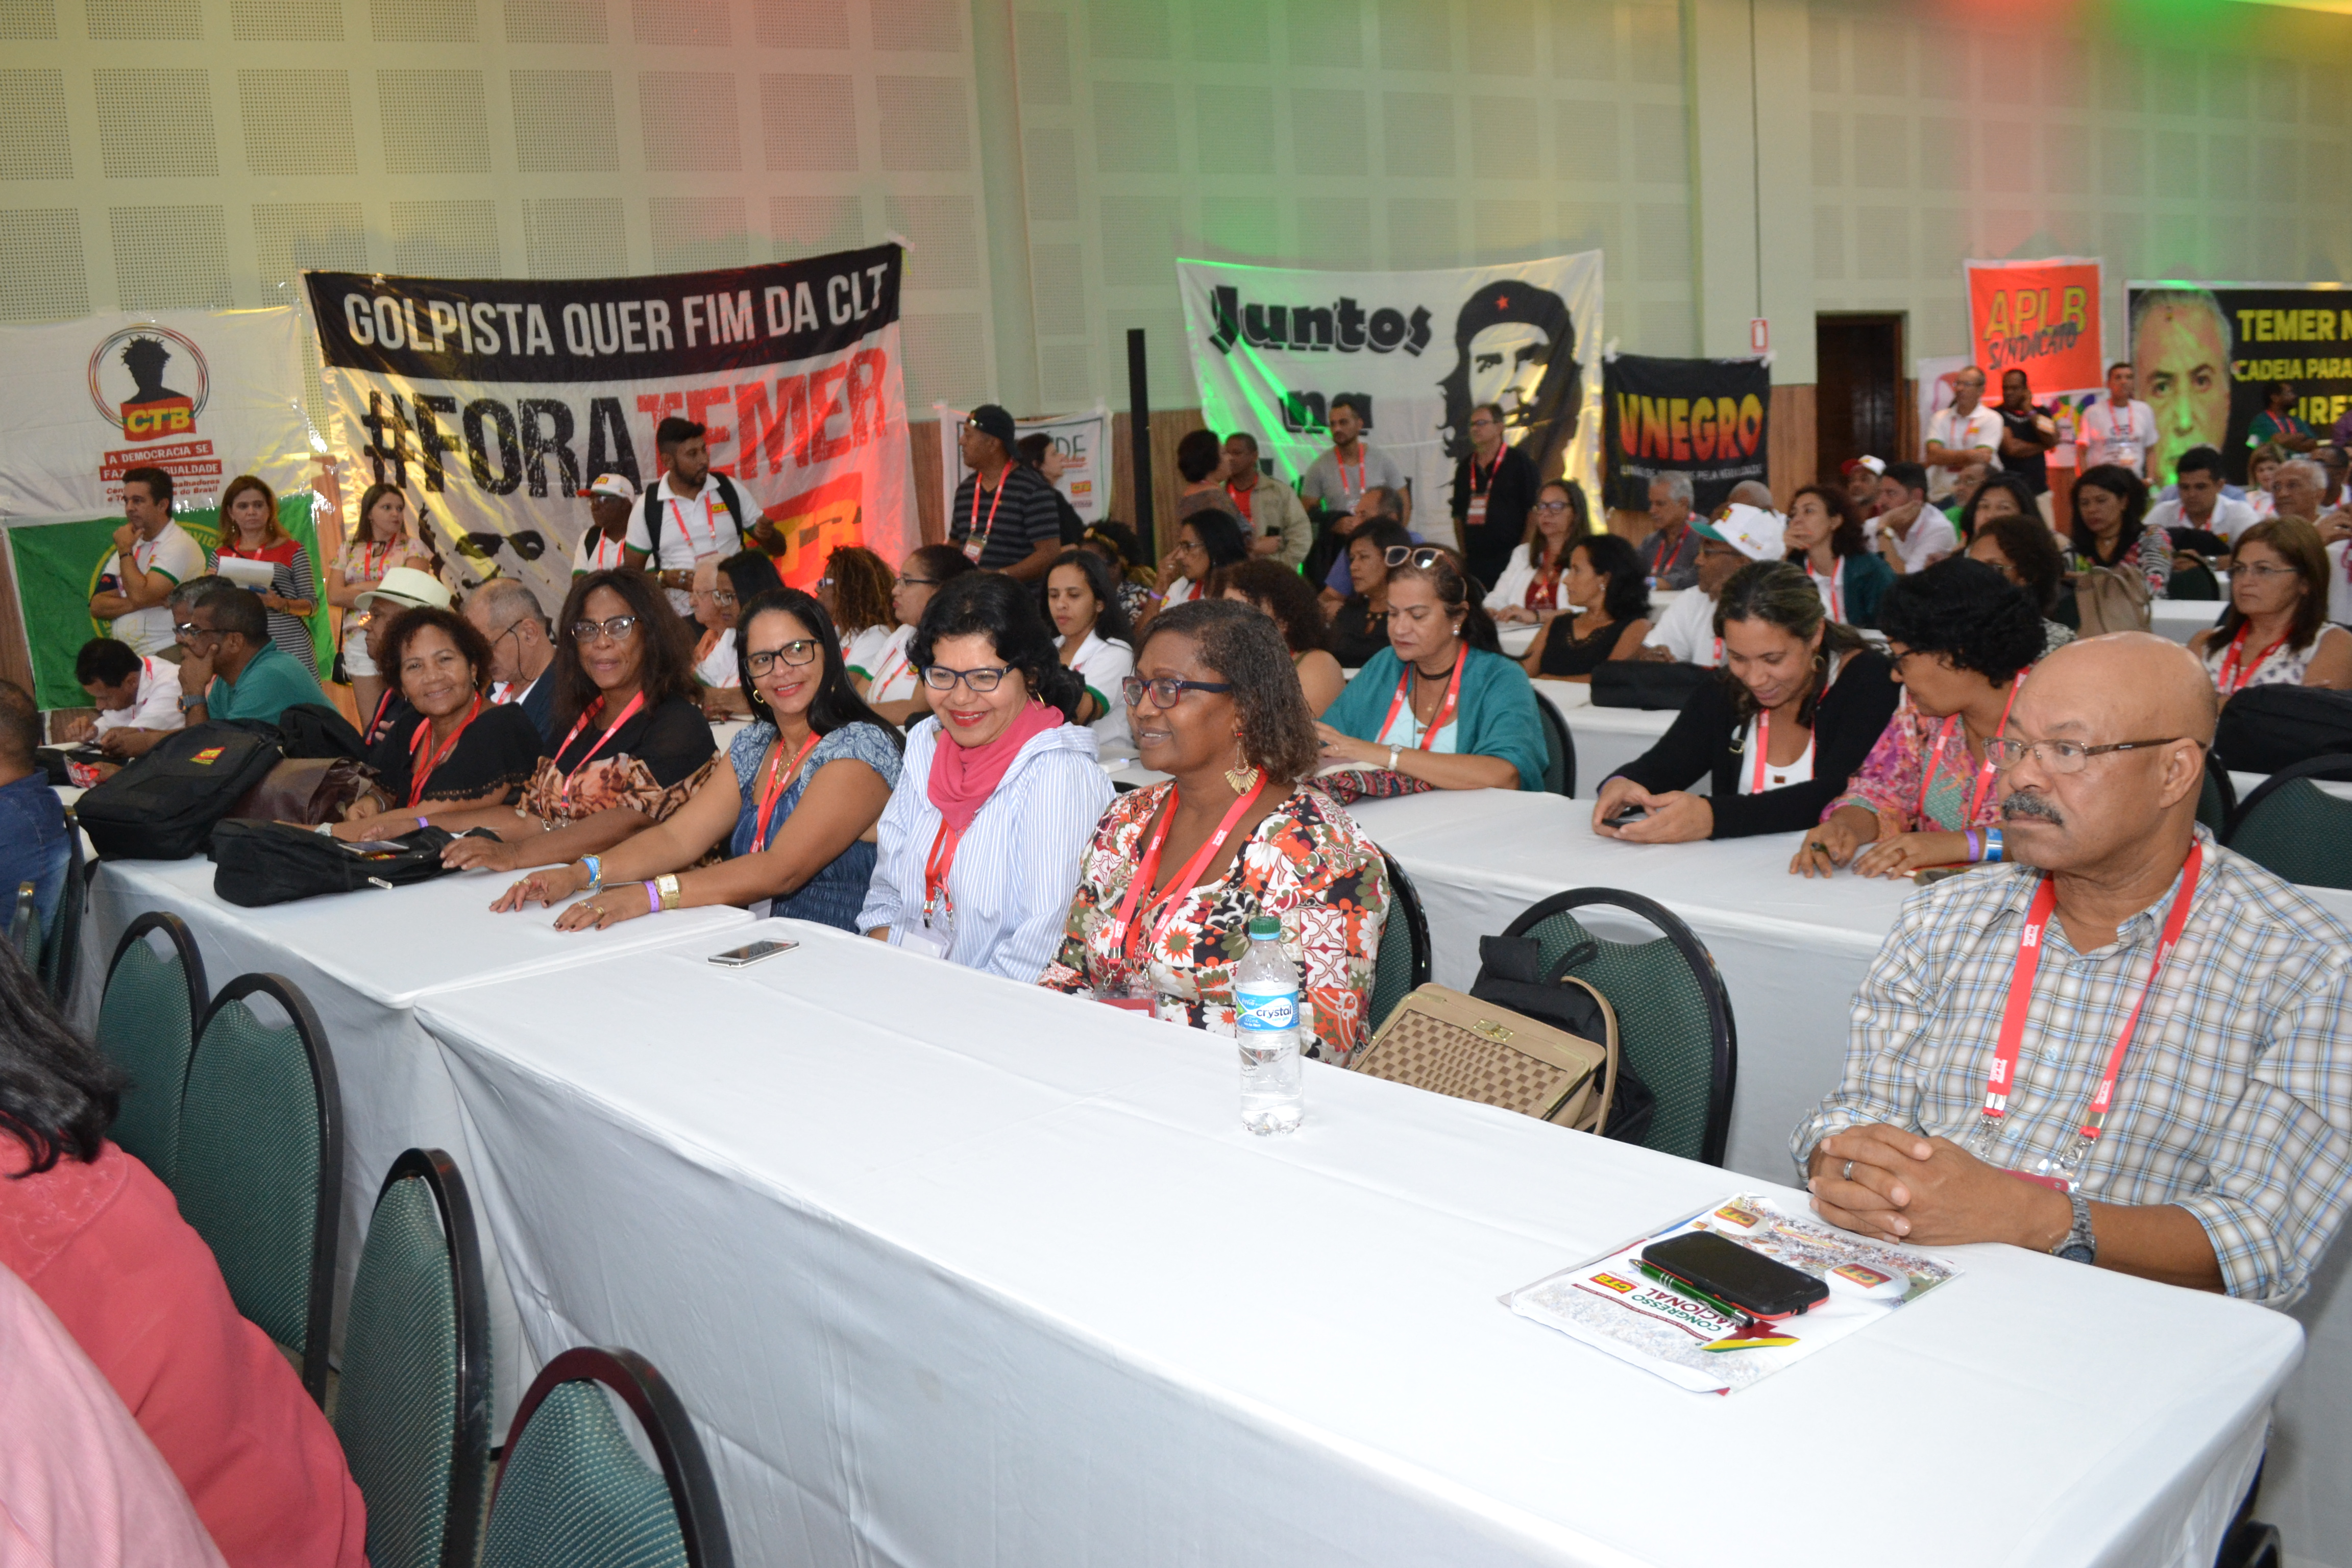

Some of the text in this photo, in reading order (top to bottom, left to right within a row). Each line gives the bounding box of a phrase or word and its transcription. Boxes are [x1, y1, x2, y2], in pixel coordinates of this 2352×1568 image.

[344, 262, 888, 357] GOLPISTA QUER FIM DA CLT
[1209, 283, 1432, 357] Juntos
[1983, 285, 2087, 341] APLB
[2236, 309, 2337, 342] TEMER
[1989, 320, 2078, 371] SINDICATO
[2233, 358, 2305, 382] CADEIA
[128, 407, 190, 433] CTB
[1616, 391, 1765, 462] UNEGRO
[109, 444, 209, 464] A DEMOCRACIA SE
[104, 469, 126, 479] FAZ
[193, 485, 218, 494] Brasil
[1256, 1004, 1291, 1019] crystal
[1594, 1274, 1632, 1292] CTB
[1631, 1294, 1722, 1332] CONGRESSO
[1645, 1287, 1735, 1328] ACIONAL
